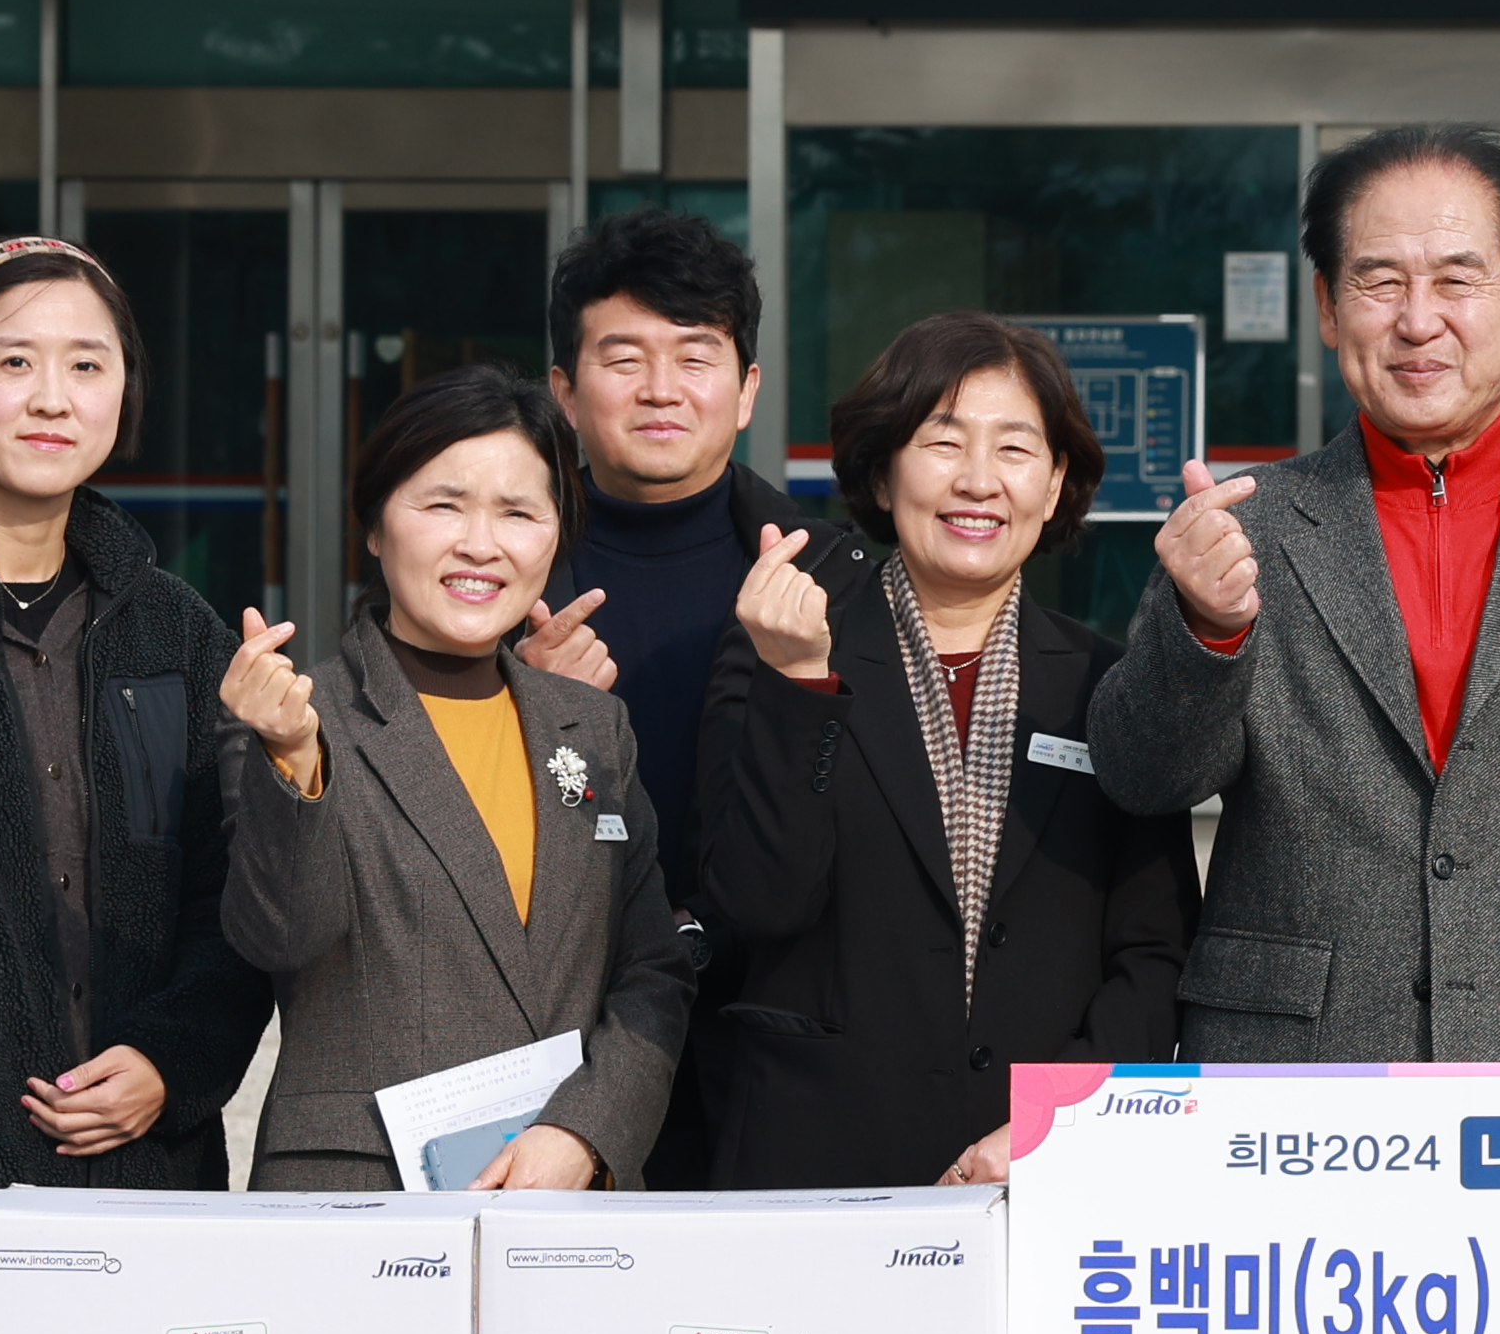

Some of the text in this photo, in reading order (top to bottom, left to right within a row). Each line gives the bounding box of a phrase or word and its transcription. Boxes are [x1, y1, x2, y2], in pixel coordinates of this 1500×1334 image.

[1096, 1093, 1181, 1116] Jindo
[1225, 1131, 1441, 1176] 희망2024
[0, 1255, 100, 1266] www.jindomg.com
[512, 1252, 612, 1264] www.jindomg.com
[886, 1249, 950, 1268] Jindo
[372, 1260, 437, 1279] Jindo
